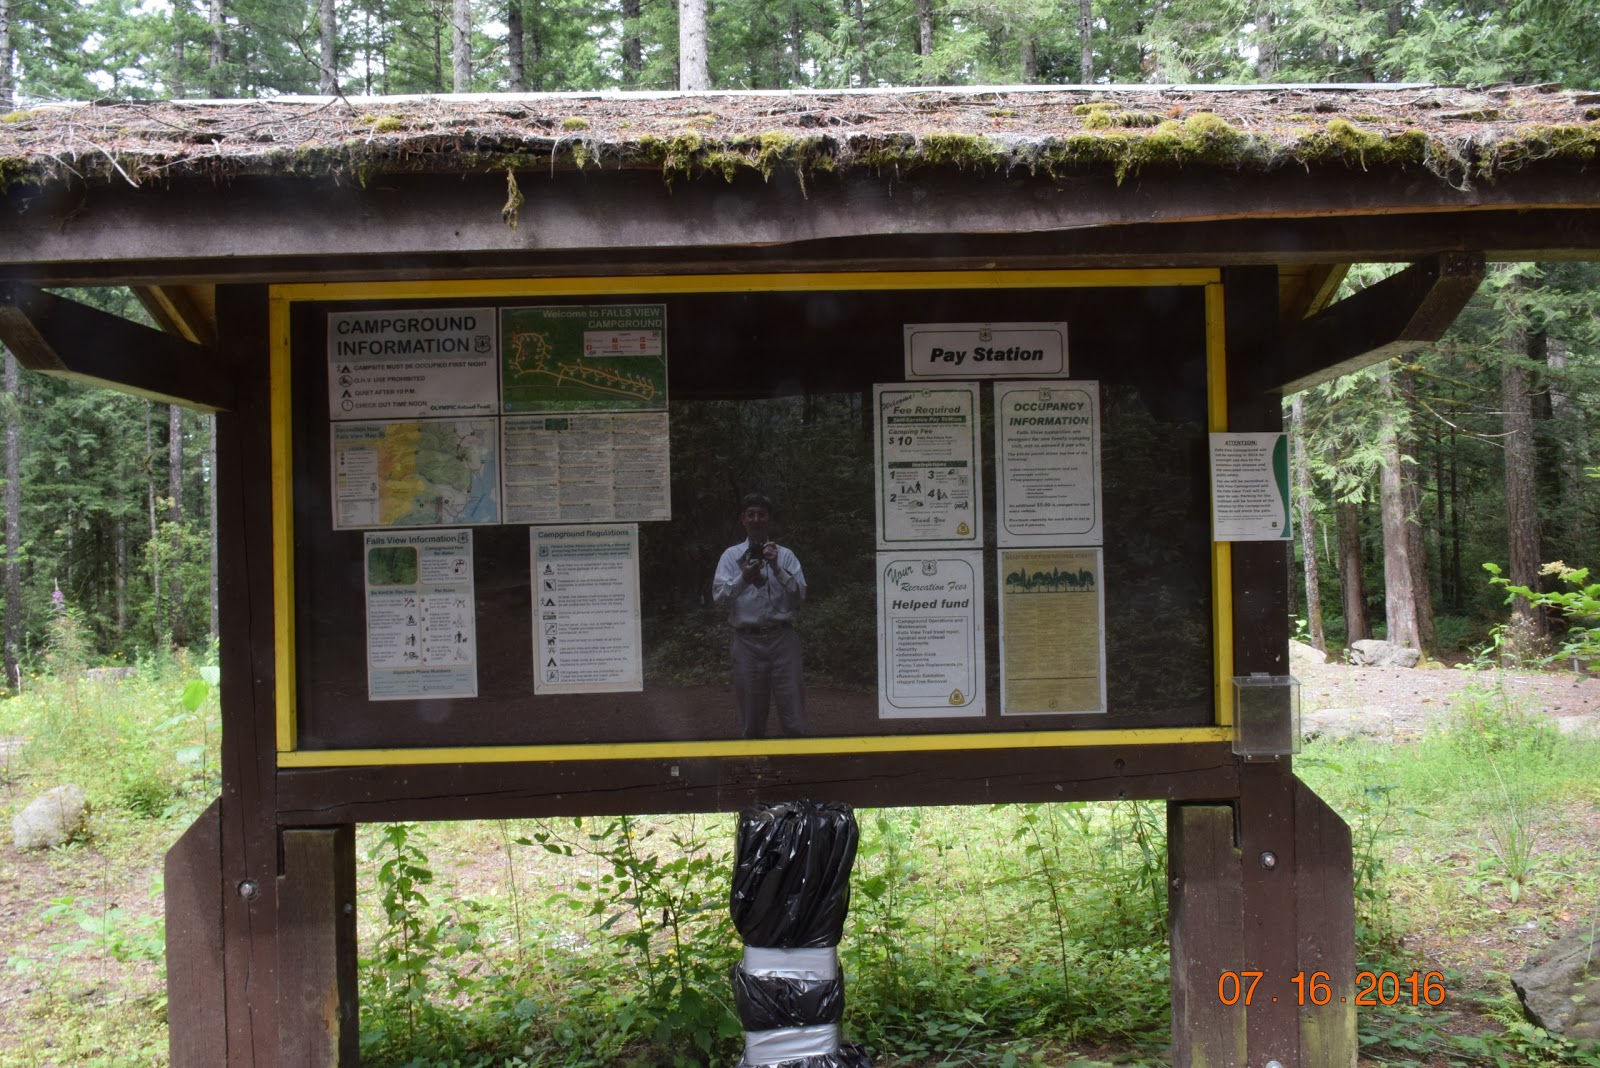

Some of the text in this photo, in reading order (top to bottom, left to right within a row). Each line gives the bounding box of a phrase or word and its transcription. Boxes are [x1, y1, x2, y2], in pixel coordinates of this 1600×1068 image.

[543, 308, 659, 318] Welcome to FALLS VIEW
[337, 317, 476, 334] CAMPGROUND
[588, 319, 662, 328] CAMPGROUND
[337, 338, 469, 356] INFORMATION
[930, 347, 1043, 365] Pay Station
[882, 395, 912, 410] Welcome
[1014, 402, 1084, 412] OCCUPANCY
[893, 406, 961, 415] Fee Required
[1010, 416, 1089, 426] INFORMATION
[890, 471, 895, 479] 1
[928, 471, 934, 479] 3
[890, 494, 896, 502] 2
[928, 489, 935, 498] 4
[366, 537, 385, 545] Falls
[409, 535, 456, 543] Information
[538, 531, 585, 539] Campground
[887, 566, 913, 586] Your
[900, 581, 966, 592] Recreation Fees
[892, 598, 969, 611] Helped fund
